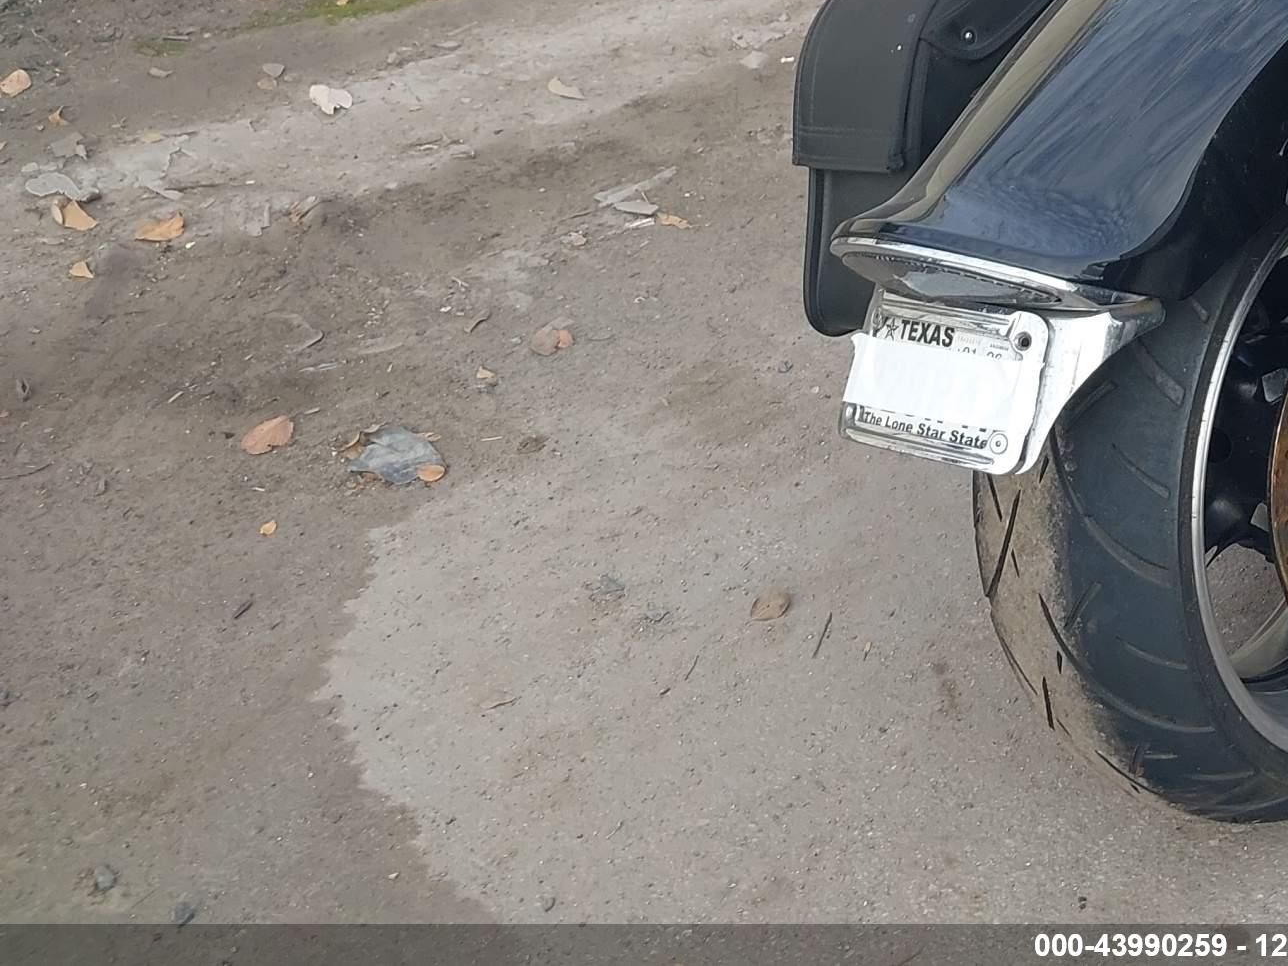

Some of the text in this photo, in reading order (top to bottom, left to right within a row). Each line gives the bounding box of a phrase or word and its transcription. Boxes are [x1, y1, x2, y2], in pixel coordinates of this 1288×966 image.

[900, 319, 955, 348] TEXAS
[864, 410, 987, 449] The Lone Star State
